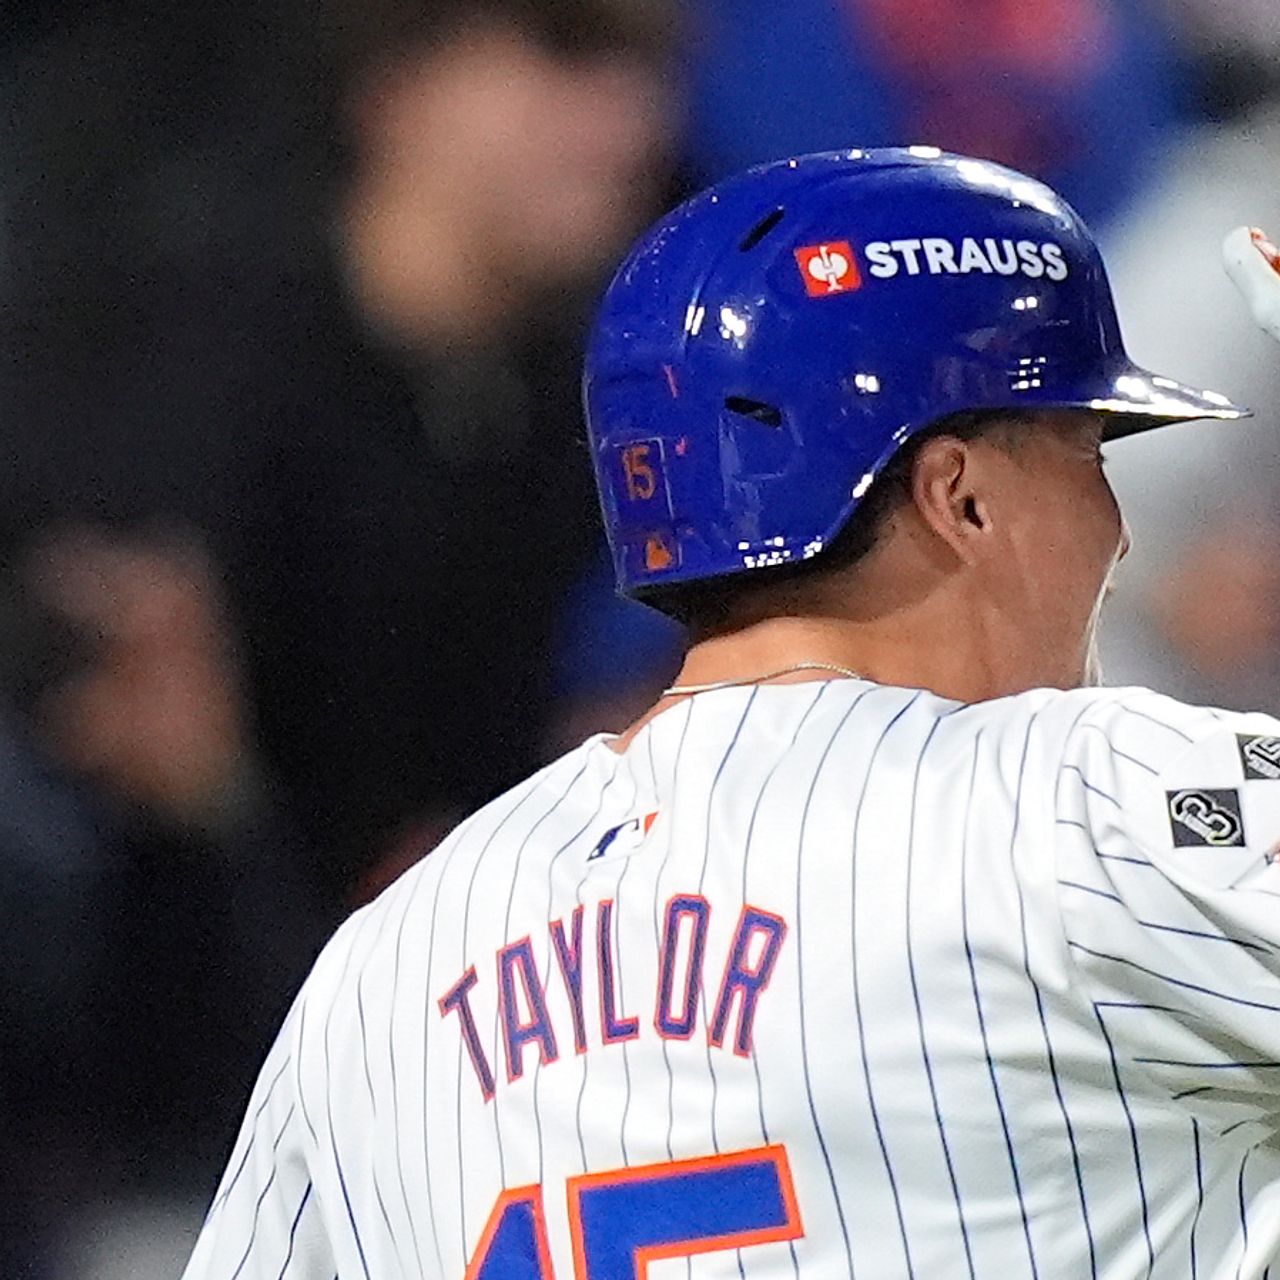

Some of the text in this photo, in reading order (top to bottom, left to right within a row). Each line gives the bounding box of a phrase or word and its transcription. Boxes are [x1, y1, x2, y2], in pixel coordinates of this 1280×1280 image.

[864, 238, 1069, 281] STRAUSS
[623, 444, 655, 501] 15
[437, 893, 788, 1105] TAYLOR
